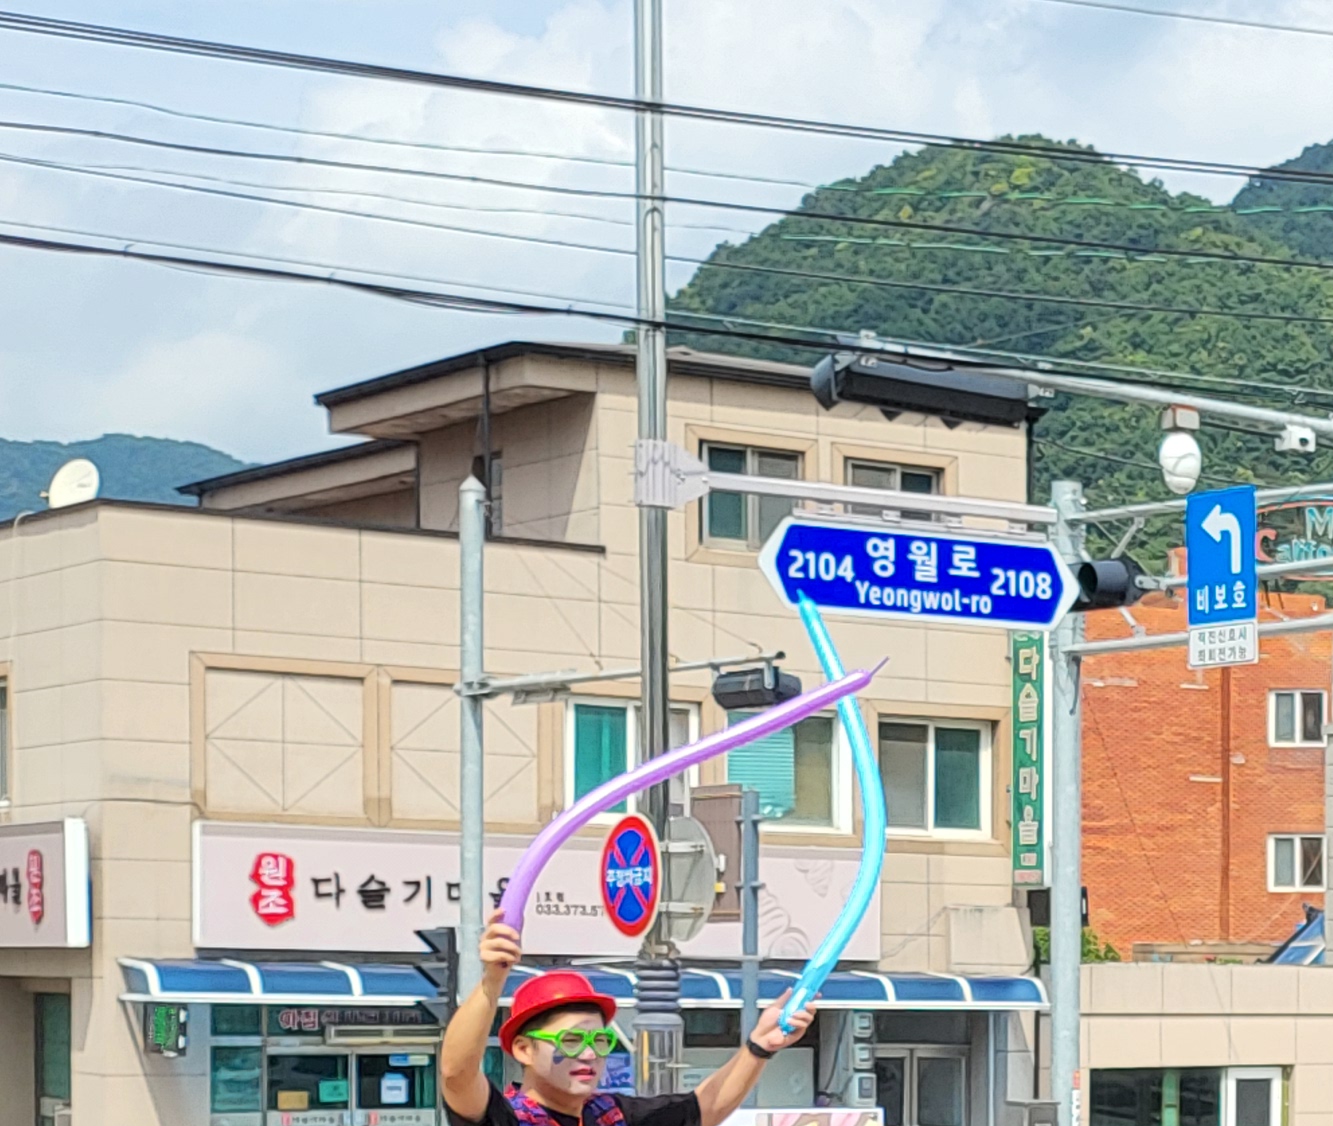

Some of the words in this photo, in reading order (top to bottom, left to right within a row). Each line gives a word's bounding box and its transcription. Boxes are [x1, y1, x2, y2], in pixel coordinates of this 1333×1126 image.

[787, 550, 855, 582] 2104
[865, 537, 981, 584] 영월로
[990, 568, 1052, 600] 2108
[855, 580, 993, 614] Yeongwol-ro
[1196, 580, 1248, 615] 비보호
[257, 853, 290, 915] 원조
